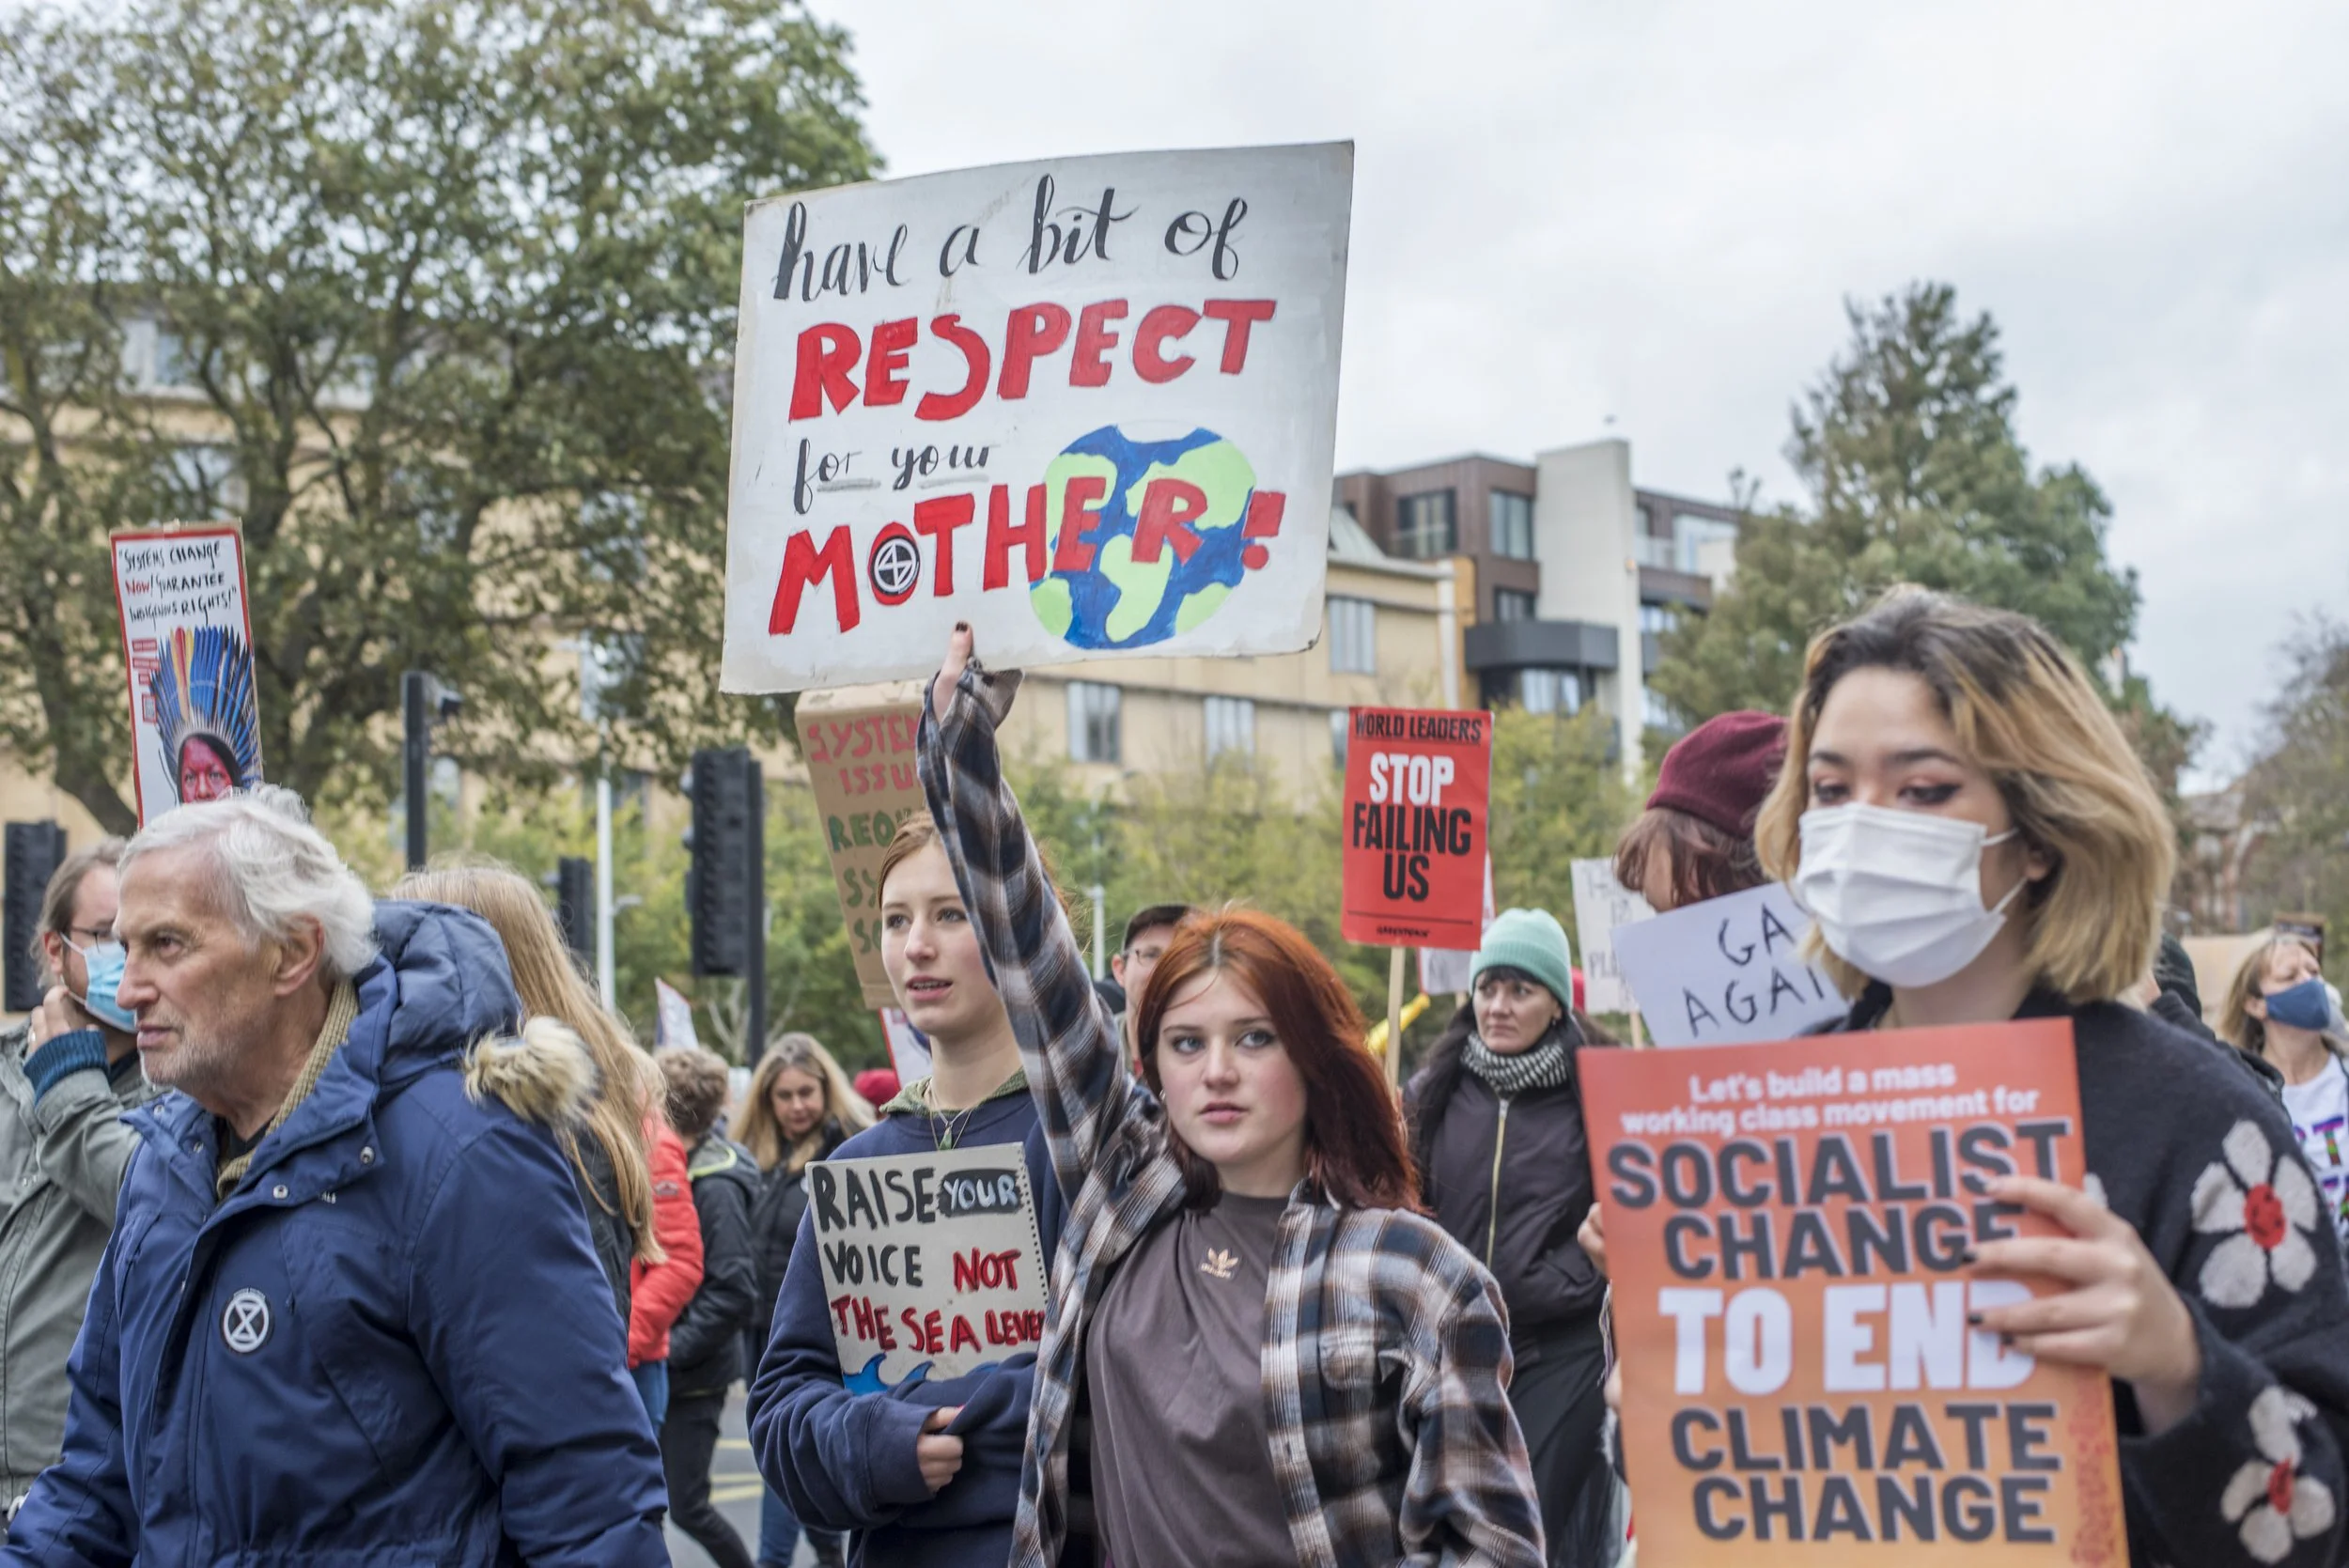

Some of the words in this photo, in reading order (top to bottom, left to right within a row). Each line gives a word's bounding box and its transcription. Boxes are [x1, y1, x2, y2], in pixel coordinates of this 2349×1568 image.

[773, 201, 910, 302] have
[941, 224, 986, 277] a
[1018, 173, 1140, 274] bit
[1164, 197, 1249, 281] of
[788, 299, 1277, 423] RESPECT
[792, 437, 862, 514] for
[169, 539, 221, 570] CHANGE
[1355, 712, 1405, 737] WORLD
[1408, 715, 1483, 744] LEADERS
[839, 762, 922, 796] ISSU
[1369, 751, 1455, 807] STOP
[1353, 801, 1472, 857] FAILING
[1382, 852, 1430, 902] US
[1621, 1108, 1735, 1138] working
[1741, 1101, 1819, 1131] class
[1824, 1090, 1989, 1126] movement
[1994, 1084, 2041, 1114] for
[1689, 1075, 1762, 1105] Let's
[1768, 1067, 1842, 1099] build
[1848, 1070, 1867, 1093] a
[1874, 1063, 1957, 1090] mass
[1607, 1116, 2073, 1211] SOCIALIST
[812, 1165, 937, 1232] RAISE
[942, 1174, 1019, 1211] YOUR
[823, 1240, 923, 1287] VOICE
[953, 1247, 1021, 1293] NOT
[1663, 1203, 2025, 1281] CHANGE
[831, 1295, 897, 1354] THE
[901, 1307, 982, 1355] SEA
[1659, 1284, 1794, 1397] TO
[1824, 1280, 2037, 1393] END
[1670, 1401, 2064, 1473] CLIMATE
[1692, 1472, 2057, 1545] CHANGE
